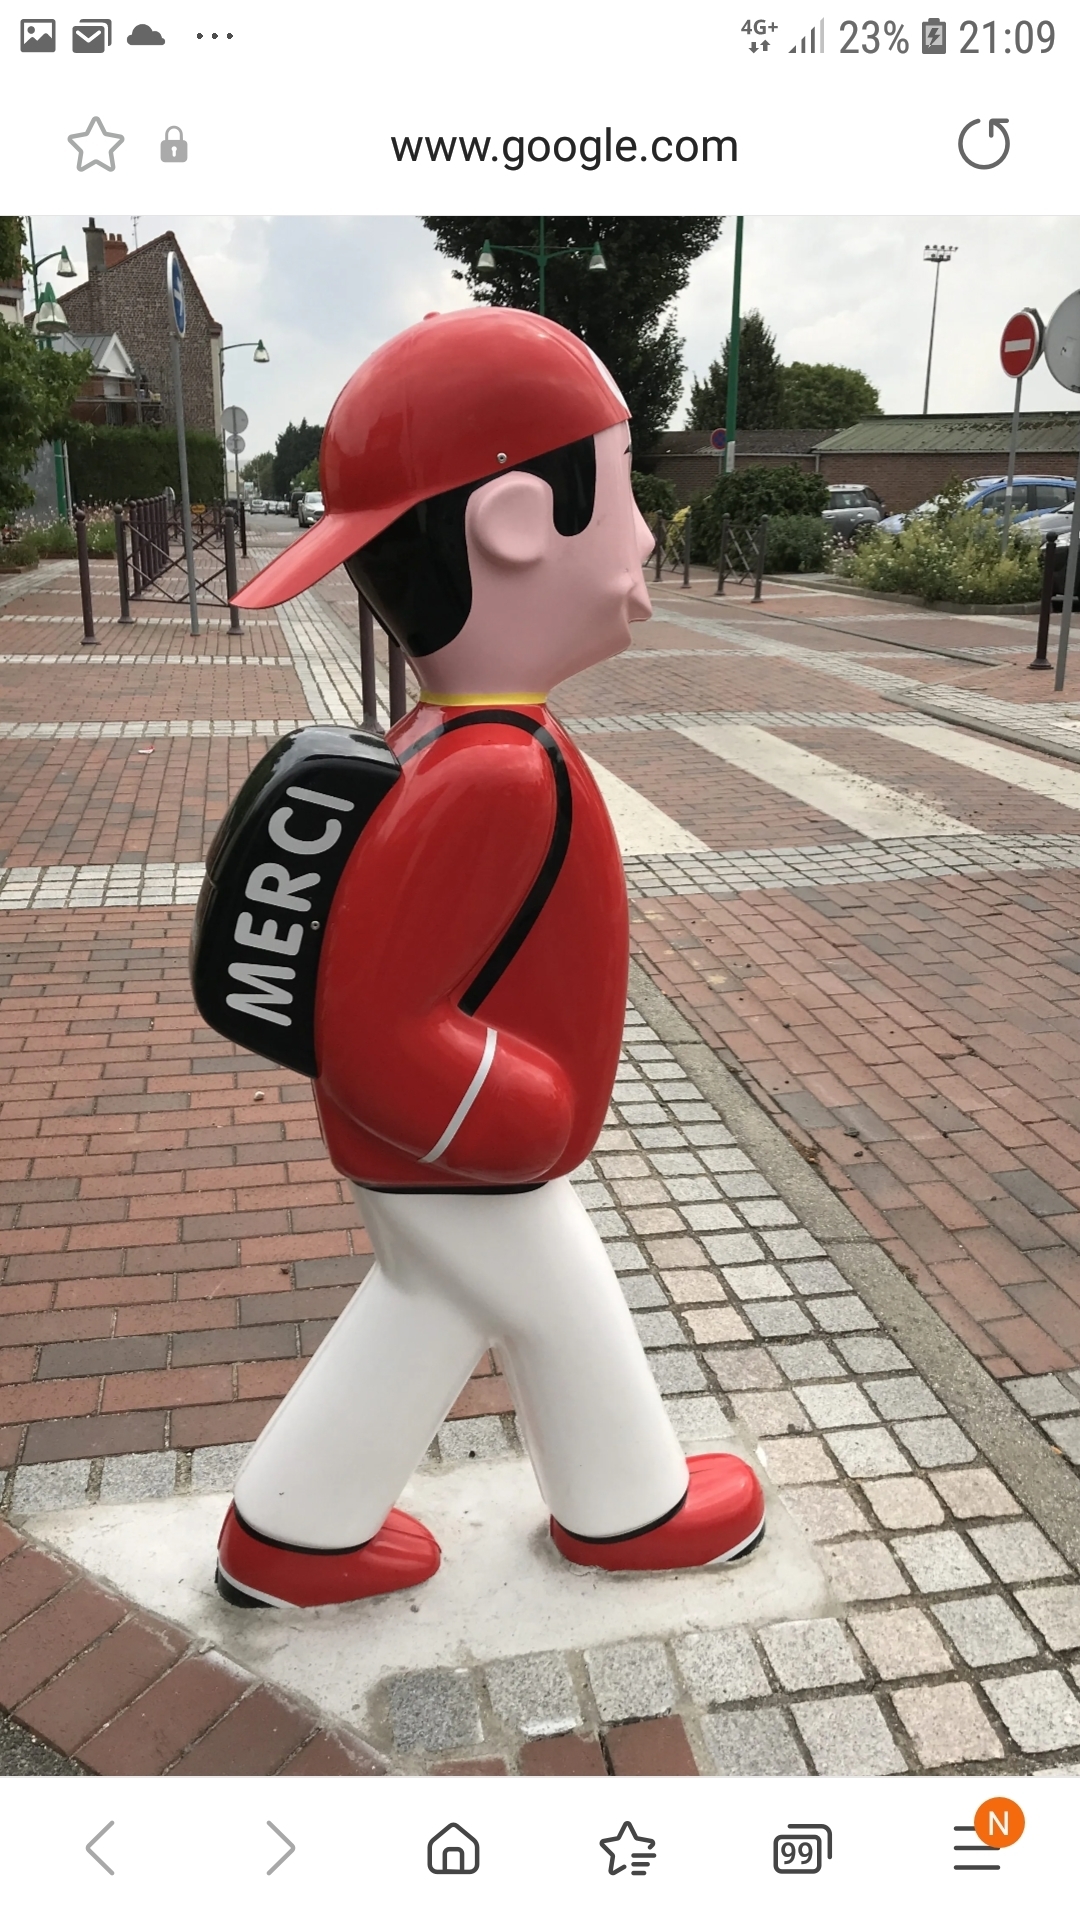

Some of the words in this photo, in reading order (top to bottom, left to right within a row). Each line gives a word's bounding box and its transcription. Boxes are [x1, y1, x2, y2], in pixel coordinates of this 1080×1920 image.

[741, 19, 778, 35] 4G+
[839, 19, 909, 54] 23%
[959, 19, 1056, 54] 21:09
[390, 127, 738, 171] www.google.com
[226, 786, 355, 1027] MERCI
[989, 1811, 1008, 1835] N
[781, 1842, 813, 1864] 99
